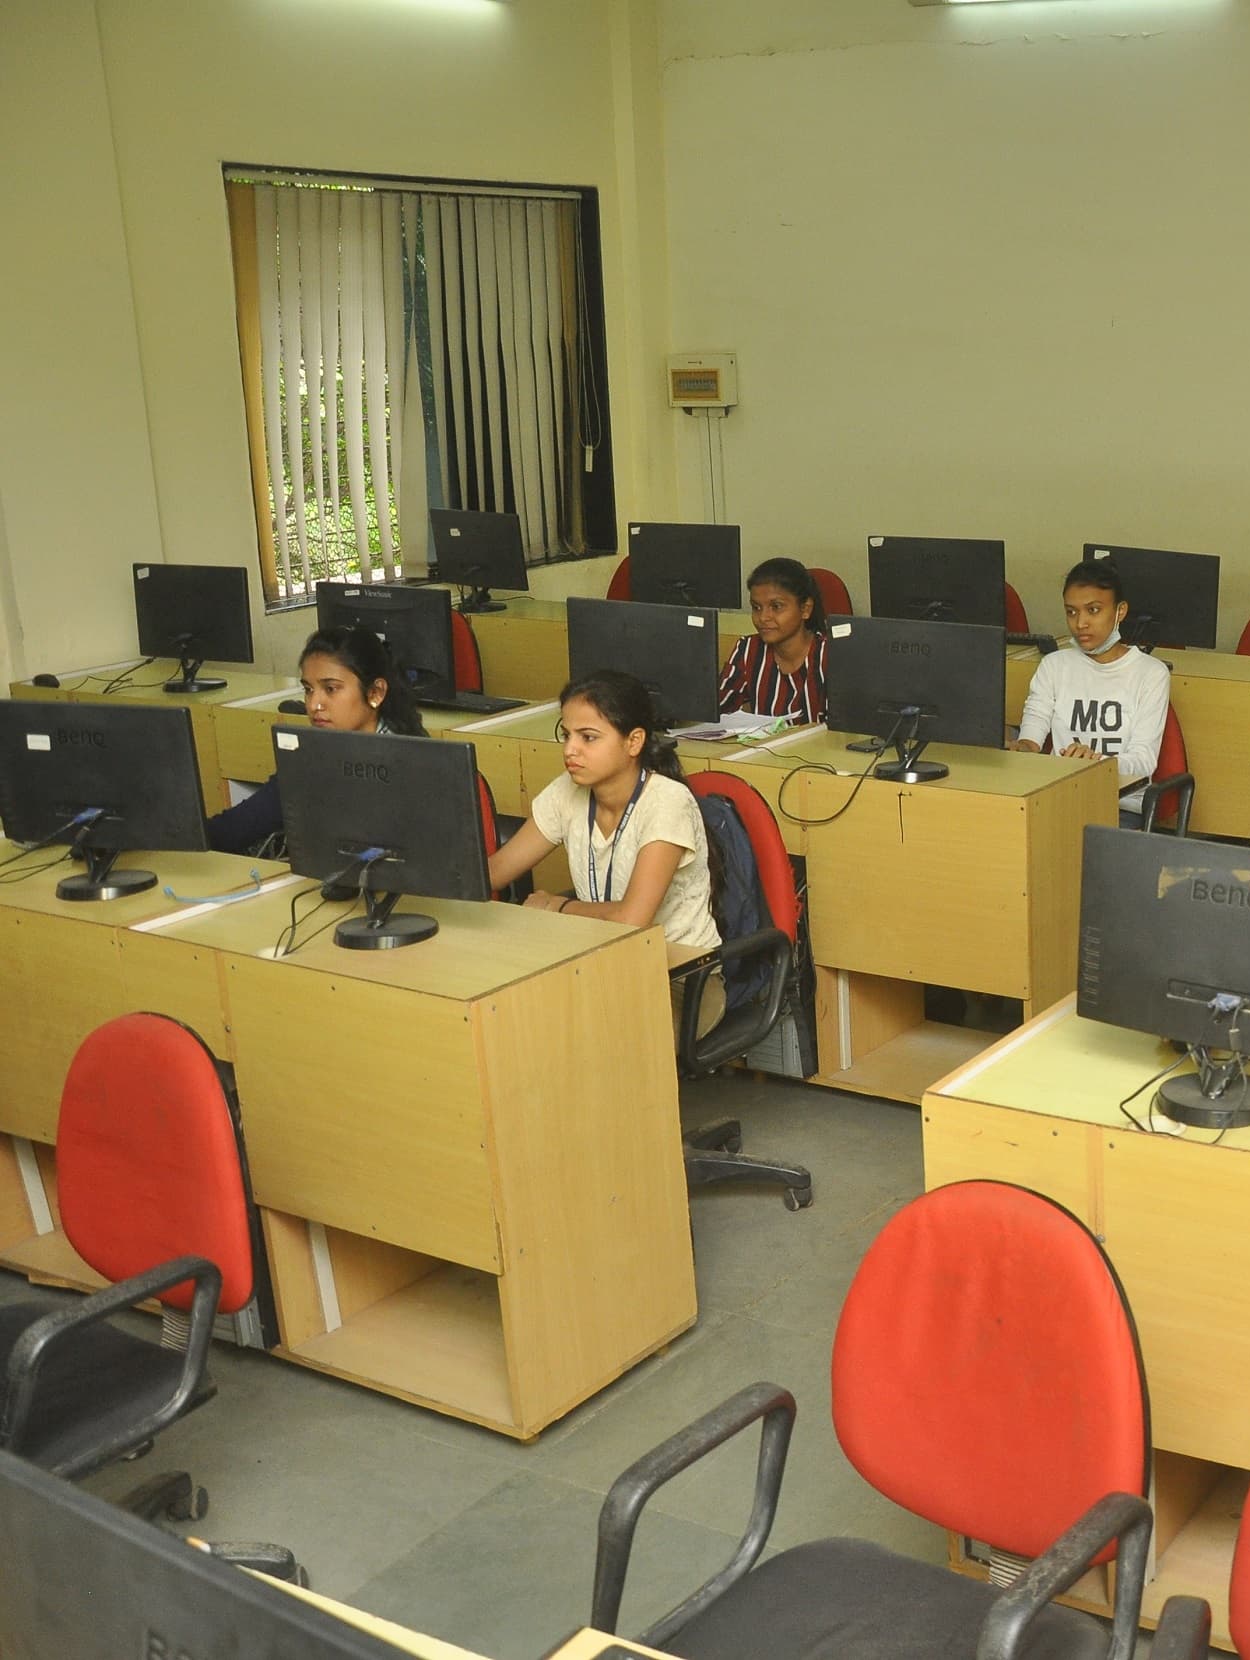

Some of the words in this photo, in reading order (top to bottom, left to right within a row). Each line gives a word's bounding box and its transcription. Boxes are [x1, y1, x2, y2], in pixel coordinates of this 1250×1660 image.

[1070, 699, 1122, 732] MO
[57, 728, 107, 748] BenQ
[343, 760, 391, 783] BenQ
